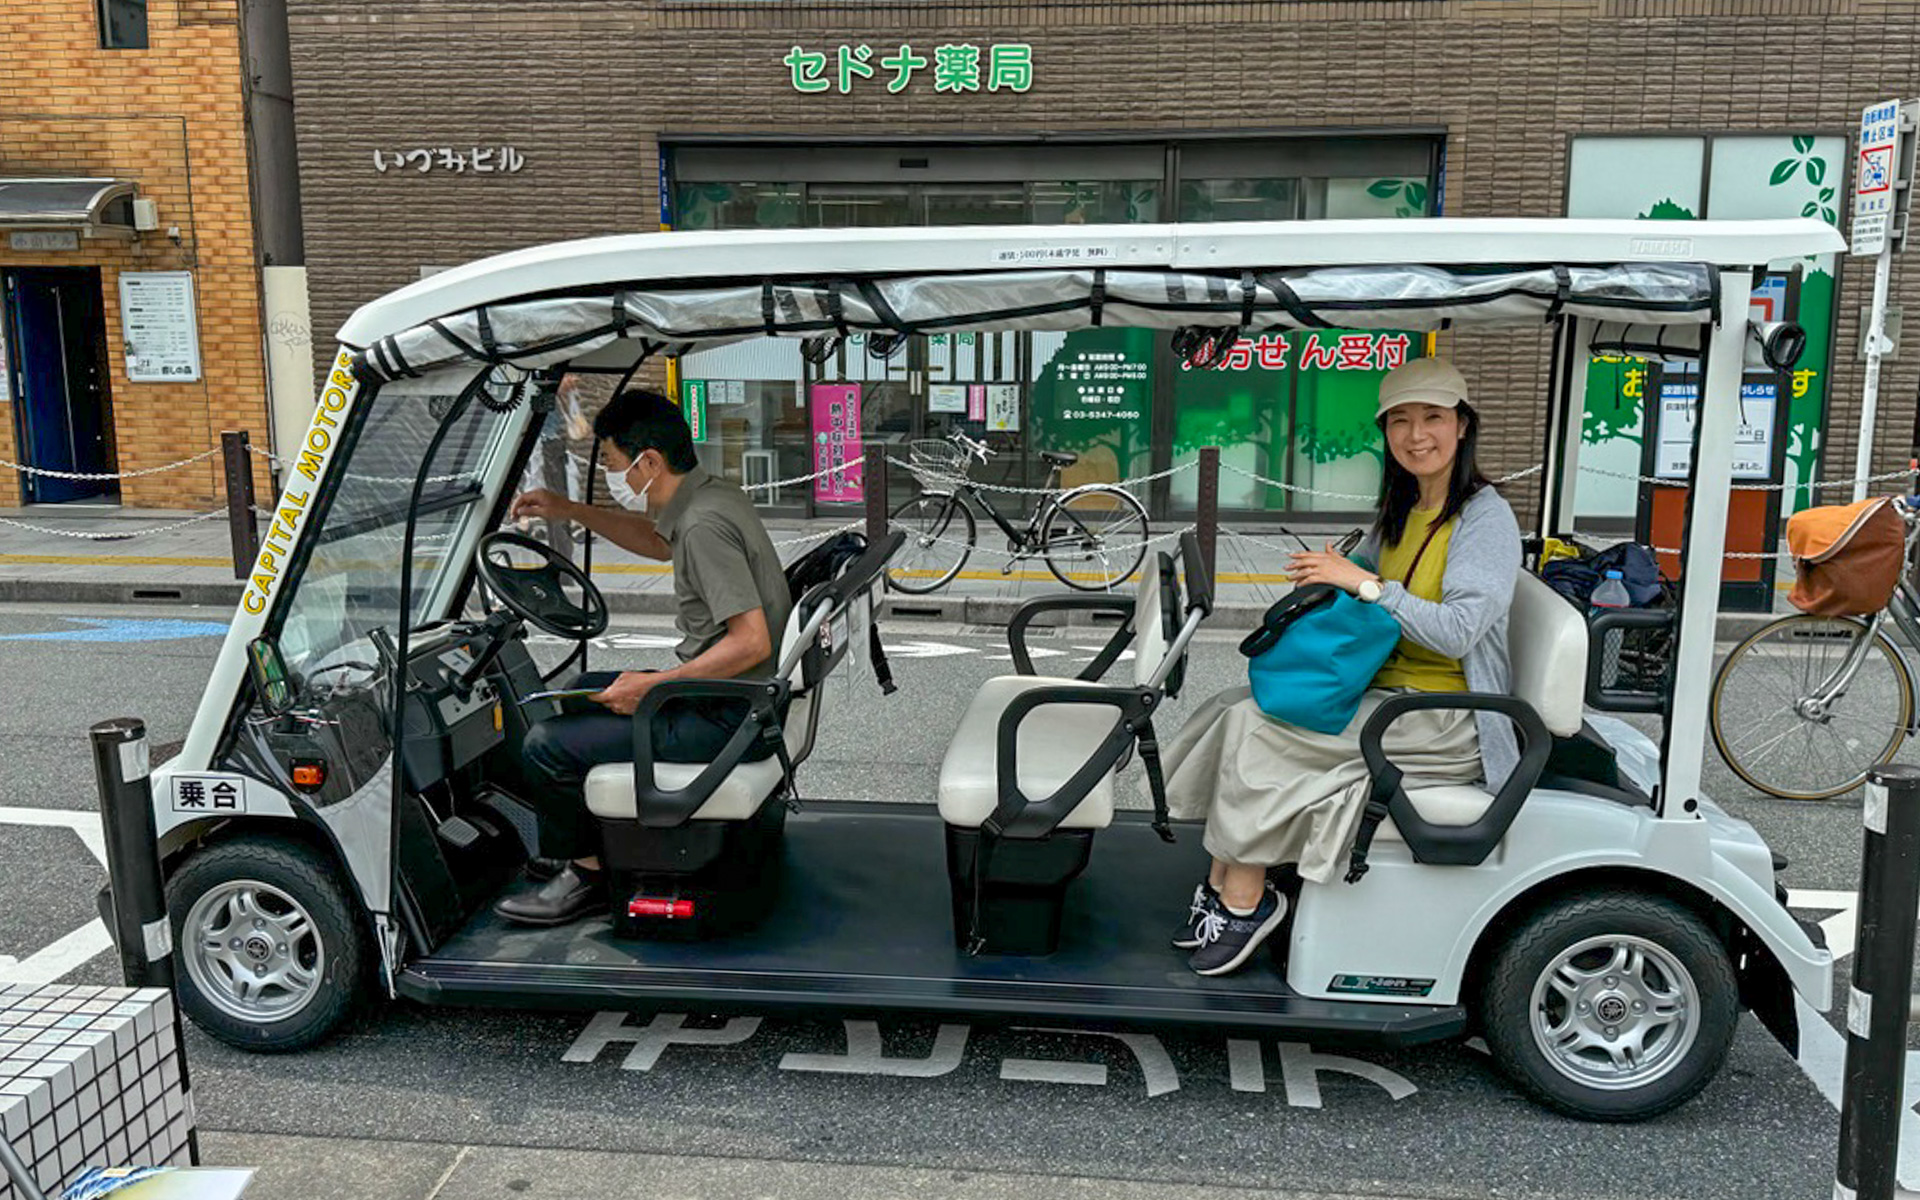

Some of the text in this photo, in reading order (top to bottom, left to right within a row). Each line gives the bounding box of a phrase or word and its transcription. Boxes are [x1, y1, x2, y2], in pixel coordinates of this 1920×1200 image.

[784, 44, 1033, 93] セドナ薬局
[373, 148, 524, 173] いづみビル
[1182, 334, 1410, 371] 方せん受付
[243, 352, 354, 616] CAPITAL MOTORS
[179, 781, 237, 809] 乗合
